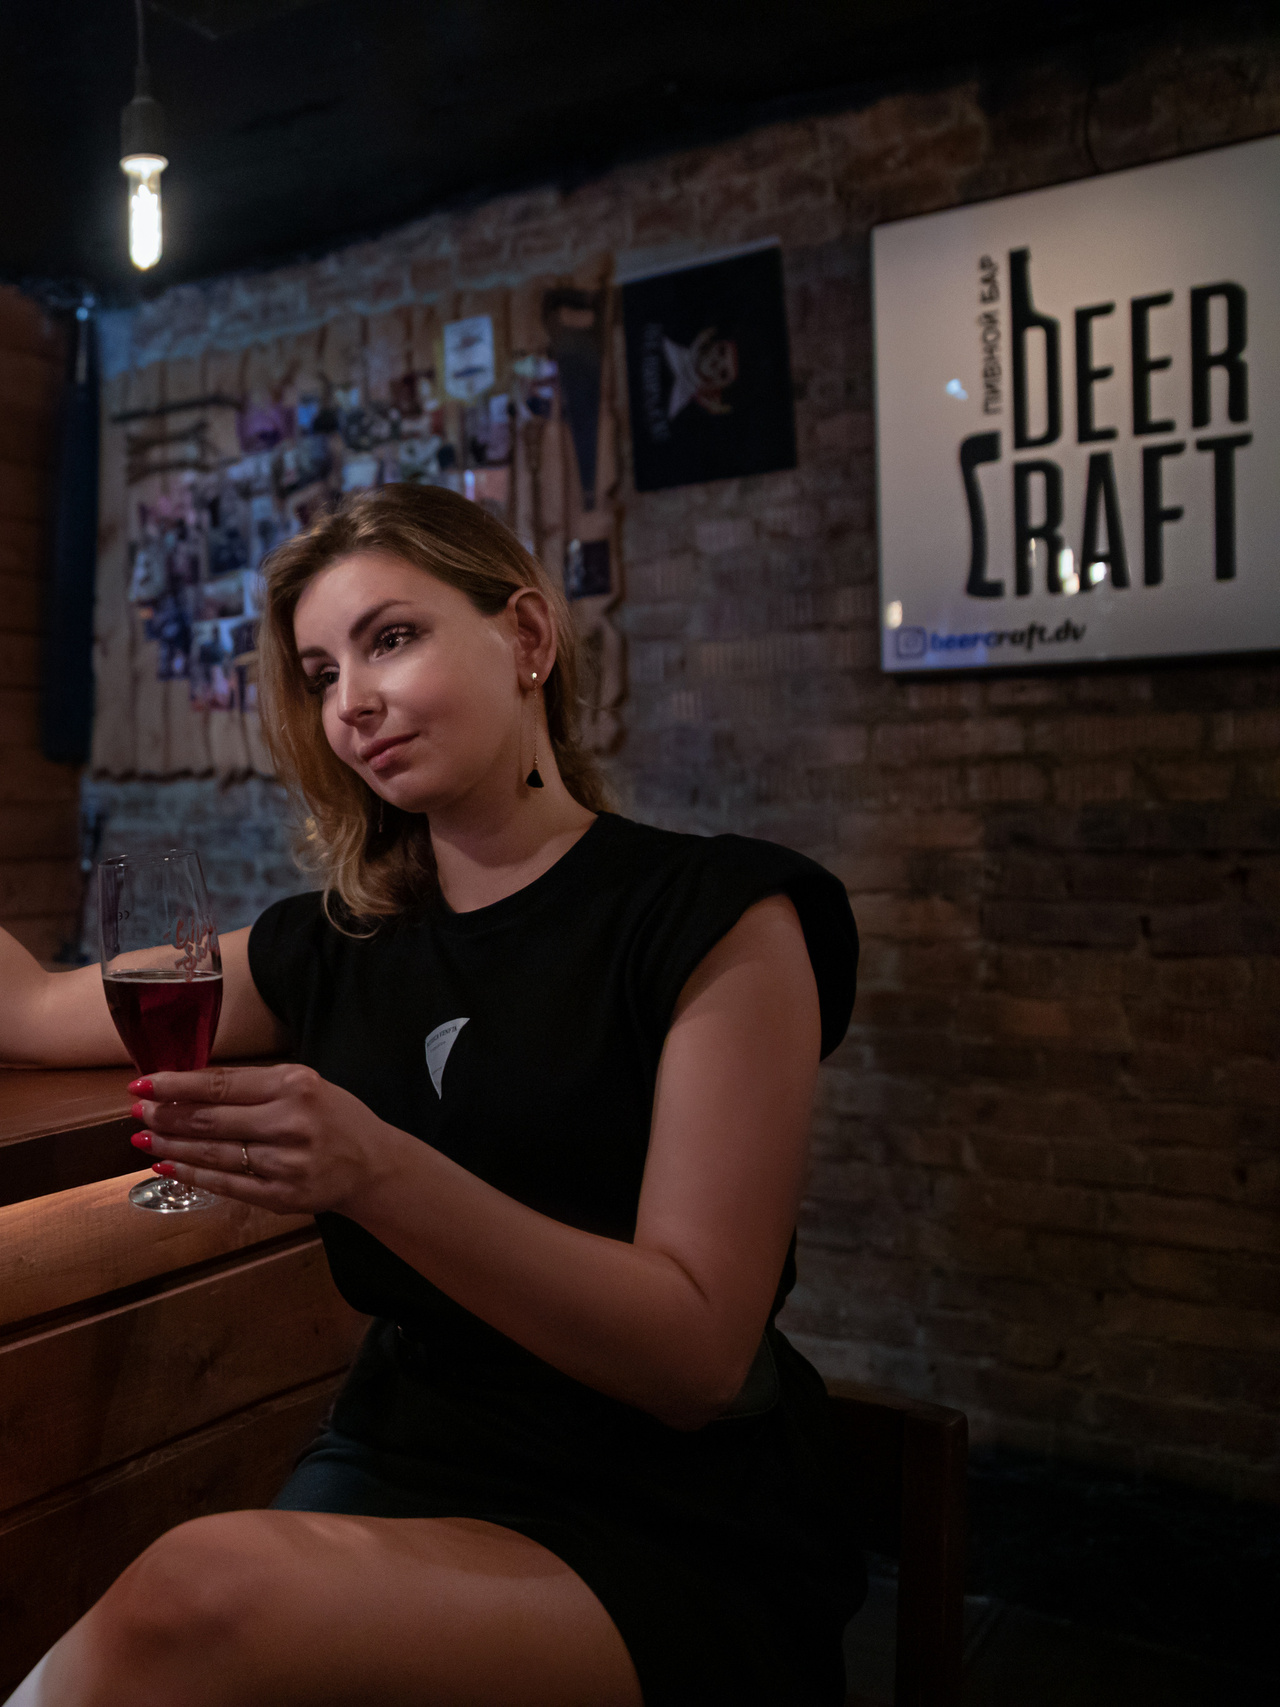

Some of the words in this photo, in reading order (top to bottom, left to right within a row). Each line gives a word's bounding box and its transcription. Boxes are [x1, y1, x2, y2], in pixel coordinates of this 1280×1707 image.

[979, 254, 1000, 304] БАР
[977, 309, 1002, 416] ПИВНОЙ
[959, 432, 1253, 599] CRAFT
